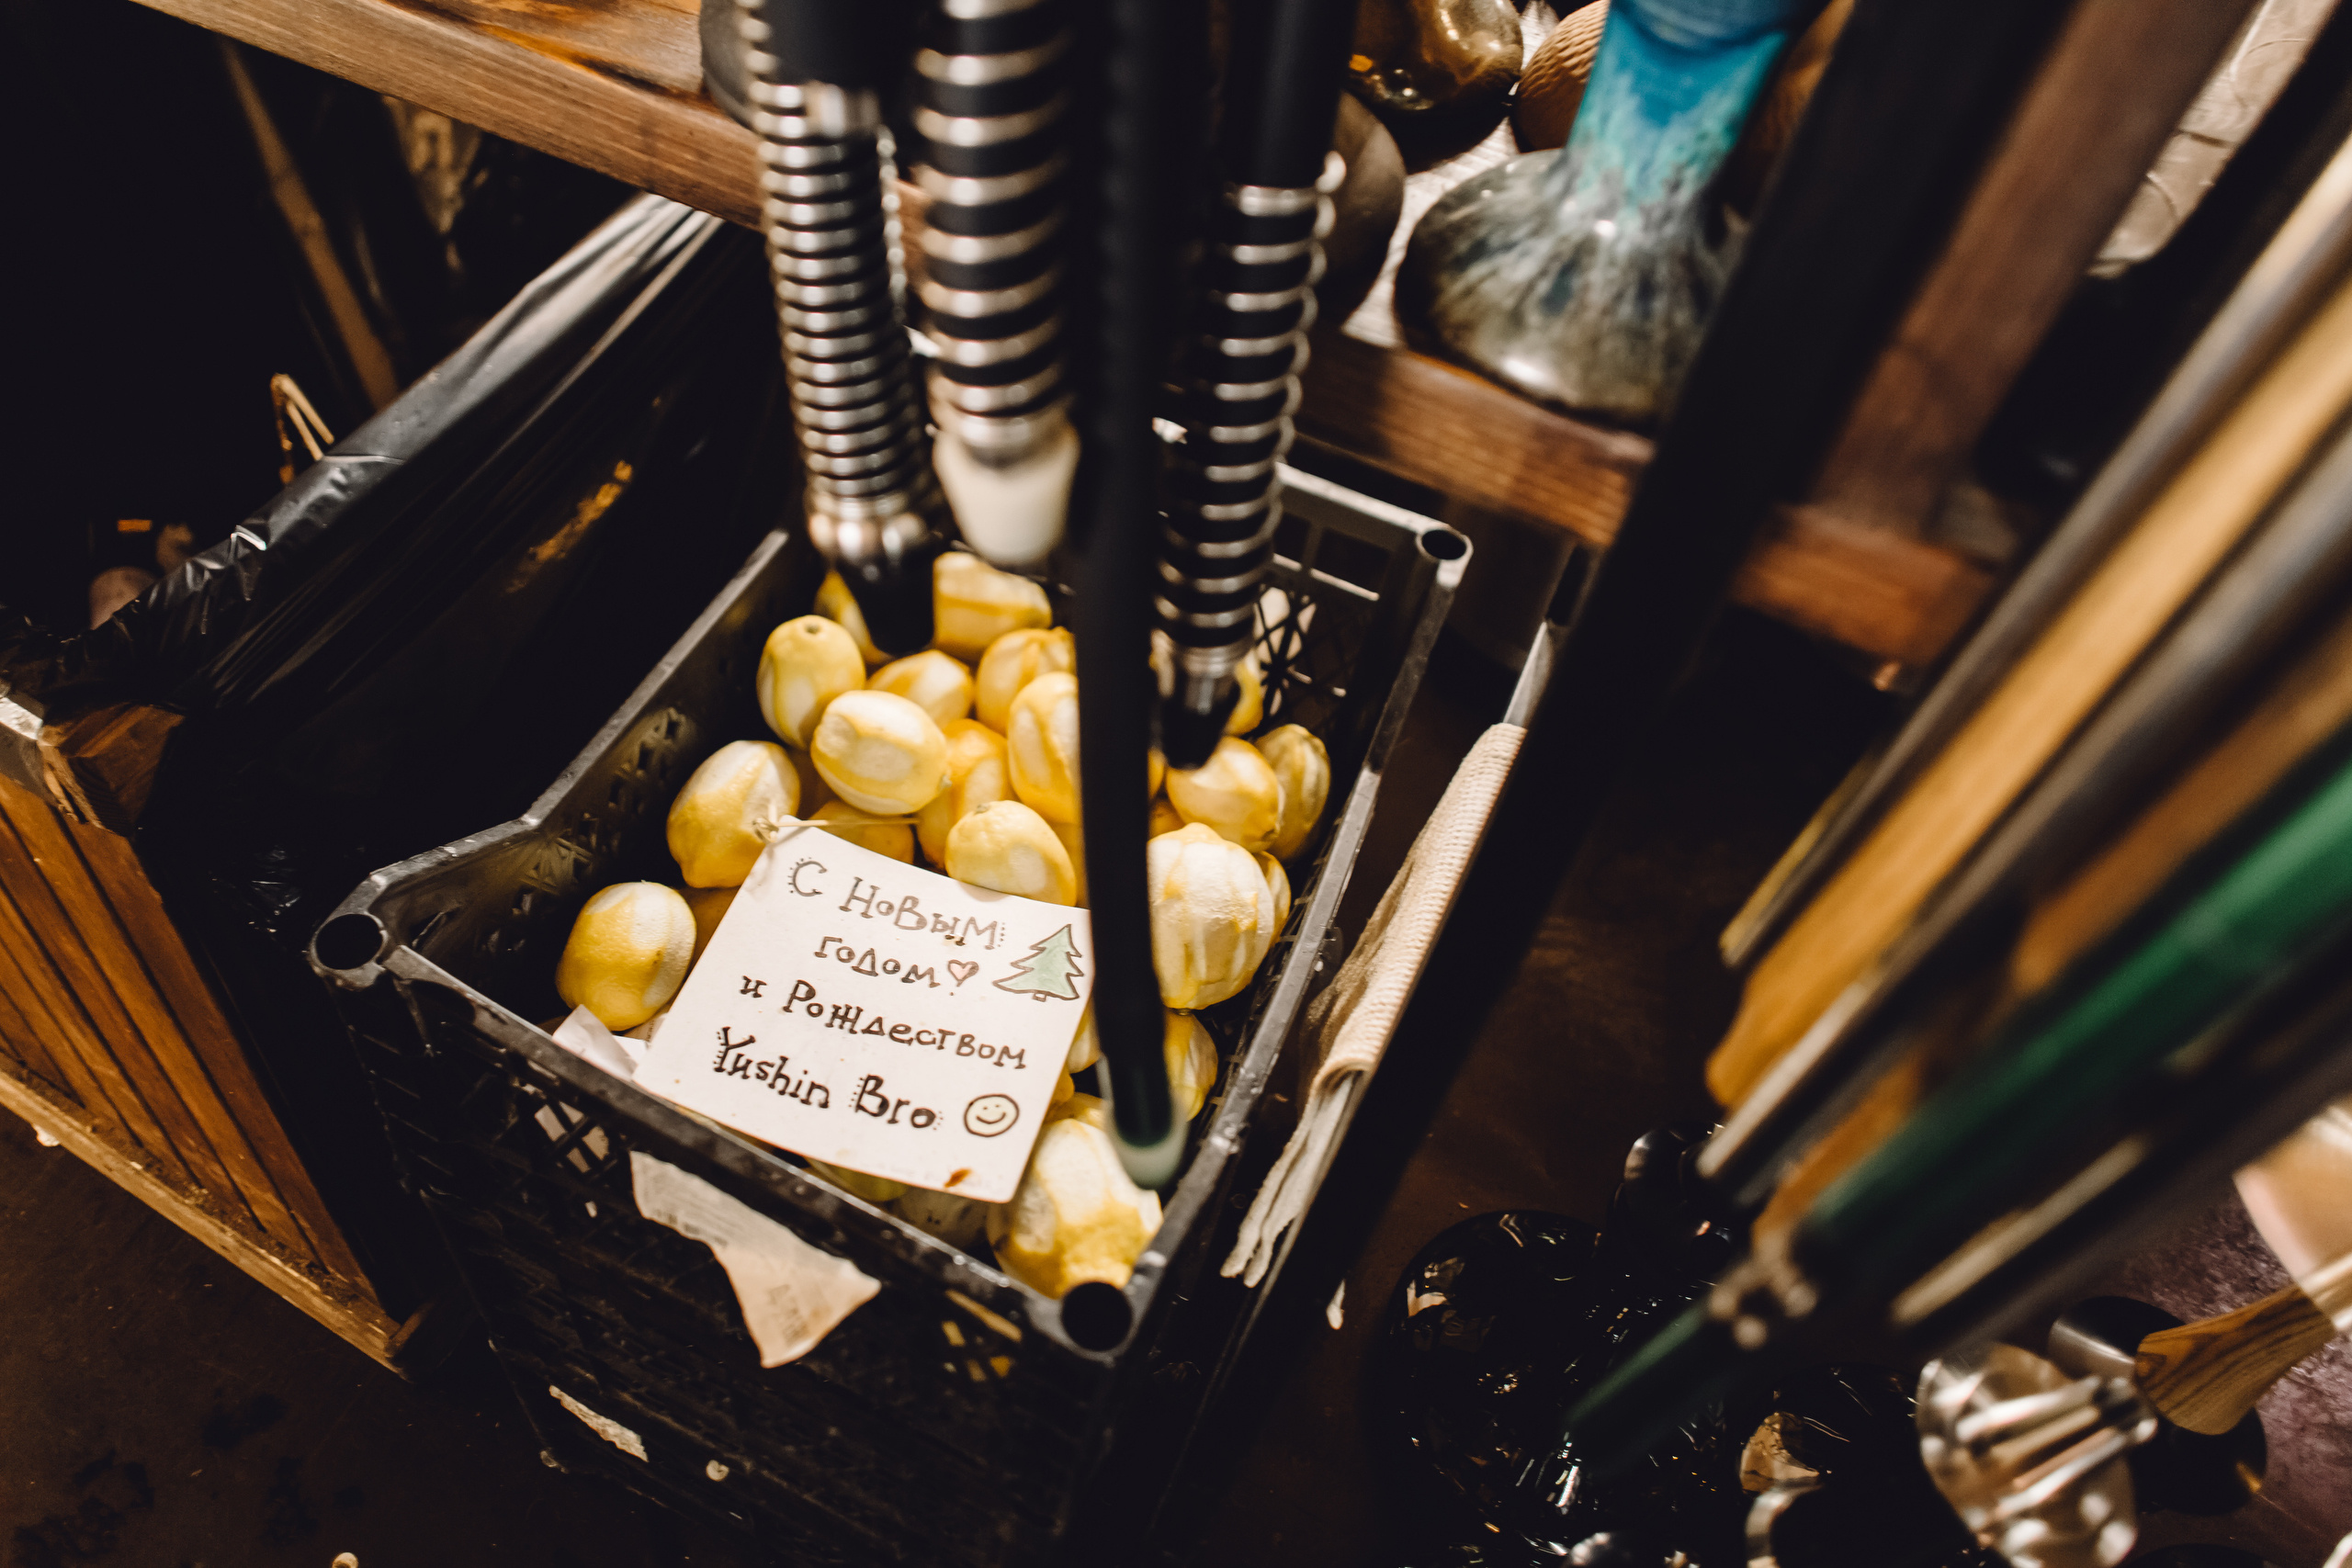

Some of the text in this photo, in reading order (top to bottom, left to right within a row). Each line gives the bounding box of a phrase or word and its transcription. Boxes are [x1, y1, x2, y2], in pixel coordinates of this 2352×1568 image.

[790, 859, 828, 897] С
[740, 975, 767, 998] и
[714, 1026, 938, 1129] Yushin Bro
